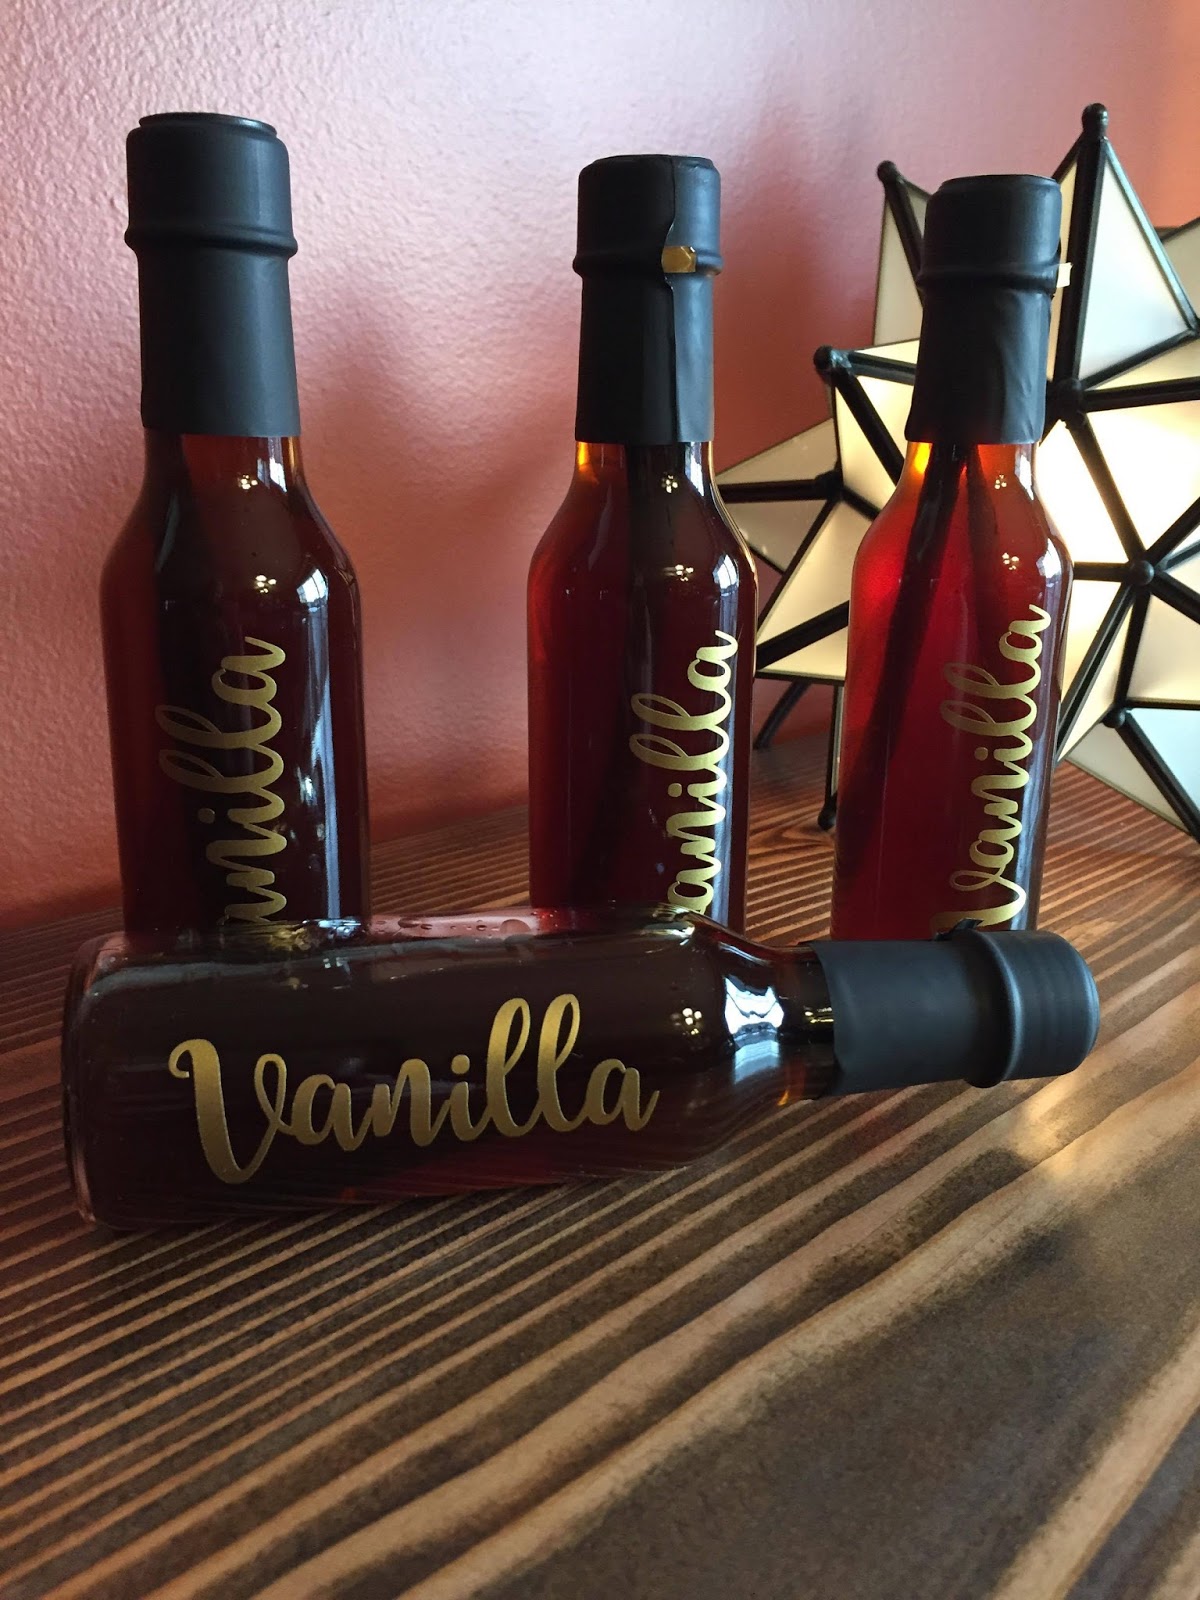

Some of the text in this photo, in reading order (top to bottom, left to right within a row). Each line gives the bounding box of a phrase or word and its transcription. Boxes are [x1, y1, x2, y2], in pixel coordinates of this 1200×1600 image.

[154, 636, 287, 924] nilla
[629, 630, 738, 914] anilla
[930, 604, 1051, 940] Vanilla
[168, 993, 660, 1184] Vanilla
